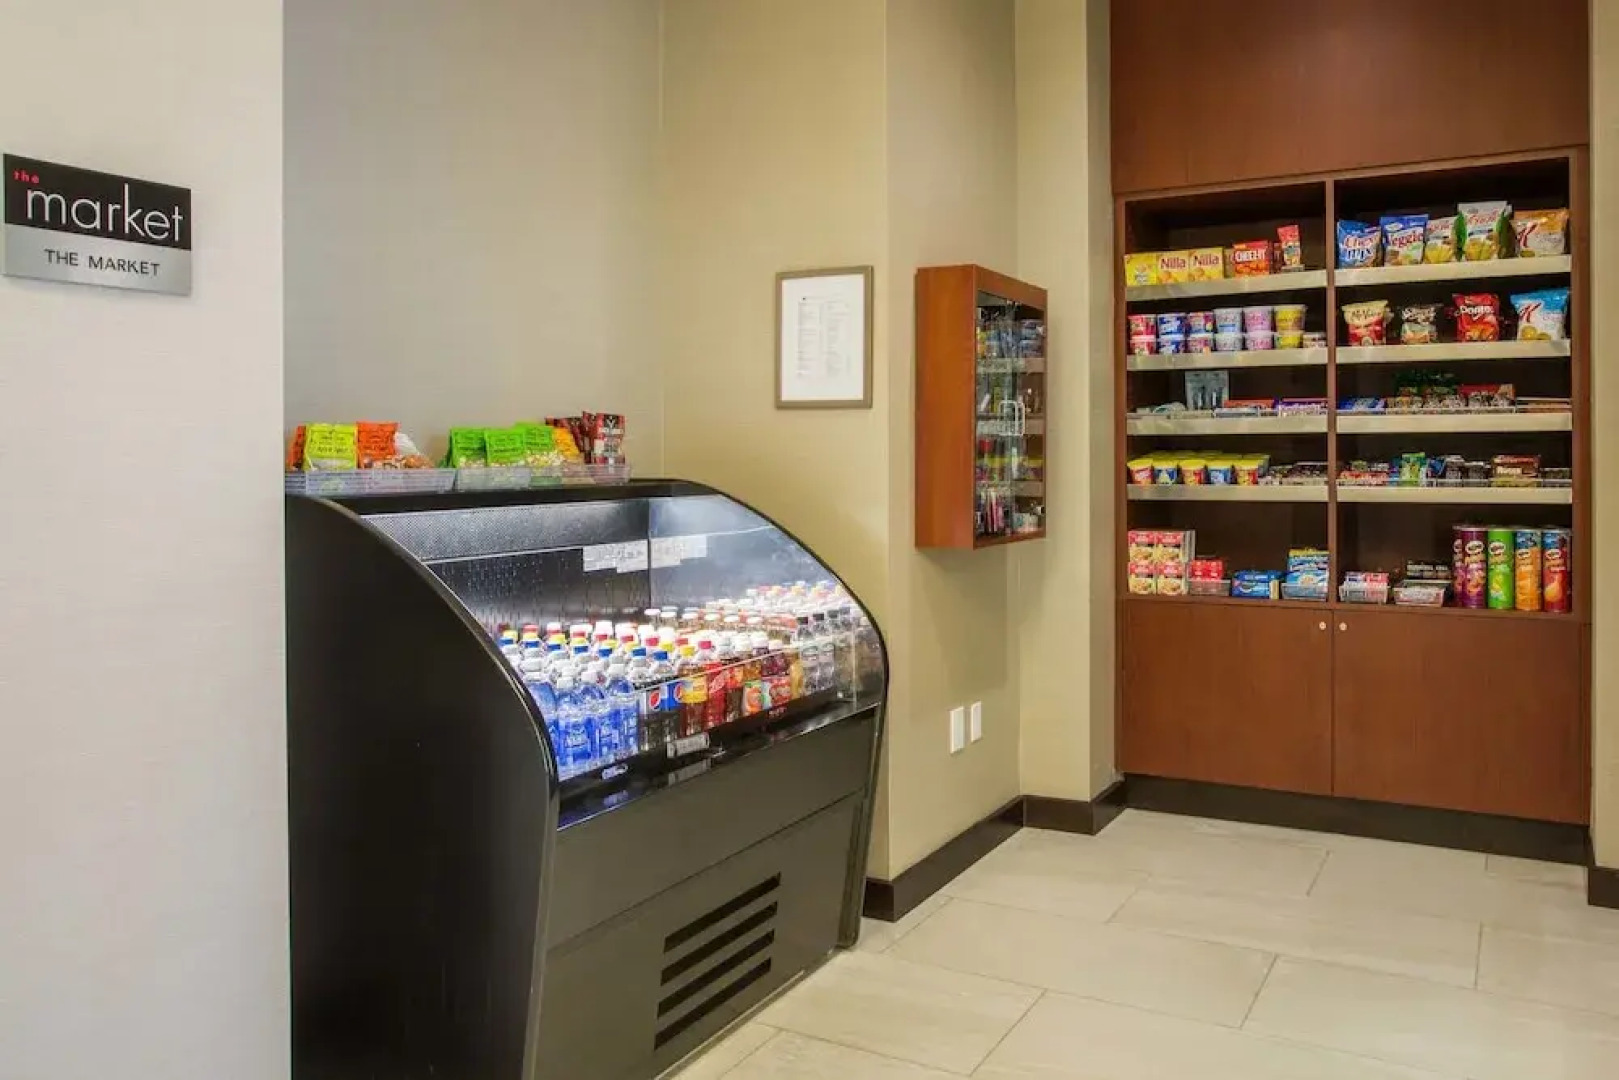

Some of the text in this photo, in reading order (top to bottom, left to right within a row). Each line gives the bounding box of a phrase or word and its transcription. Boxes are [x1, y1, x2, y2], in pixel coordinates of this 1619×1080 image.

[13, 170, 40, 184] the
[26, 182, 184, 241] market
[44, 248, 161, 276] THE MARKET
[1160, 256, 1187, 270] Nilla
[1193, 253, 1220, 268] Nilla
